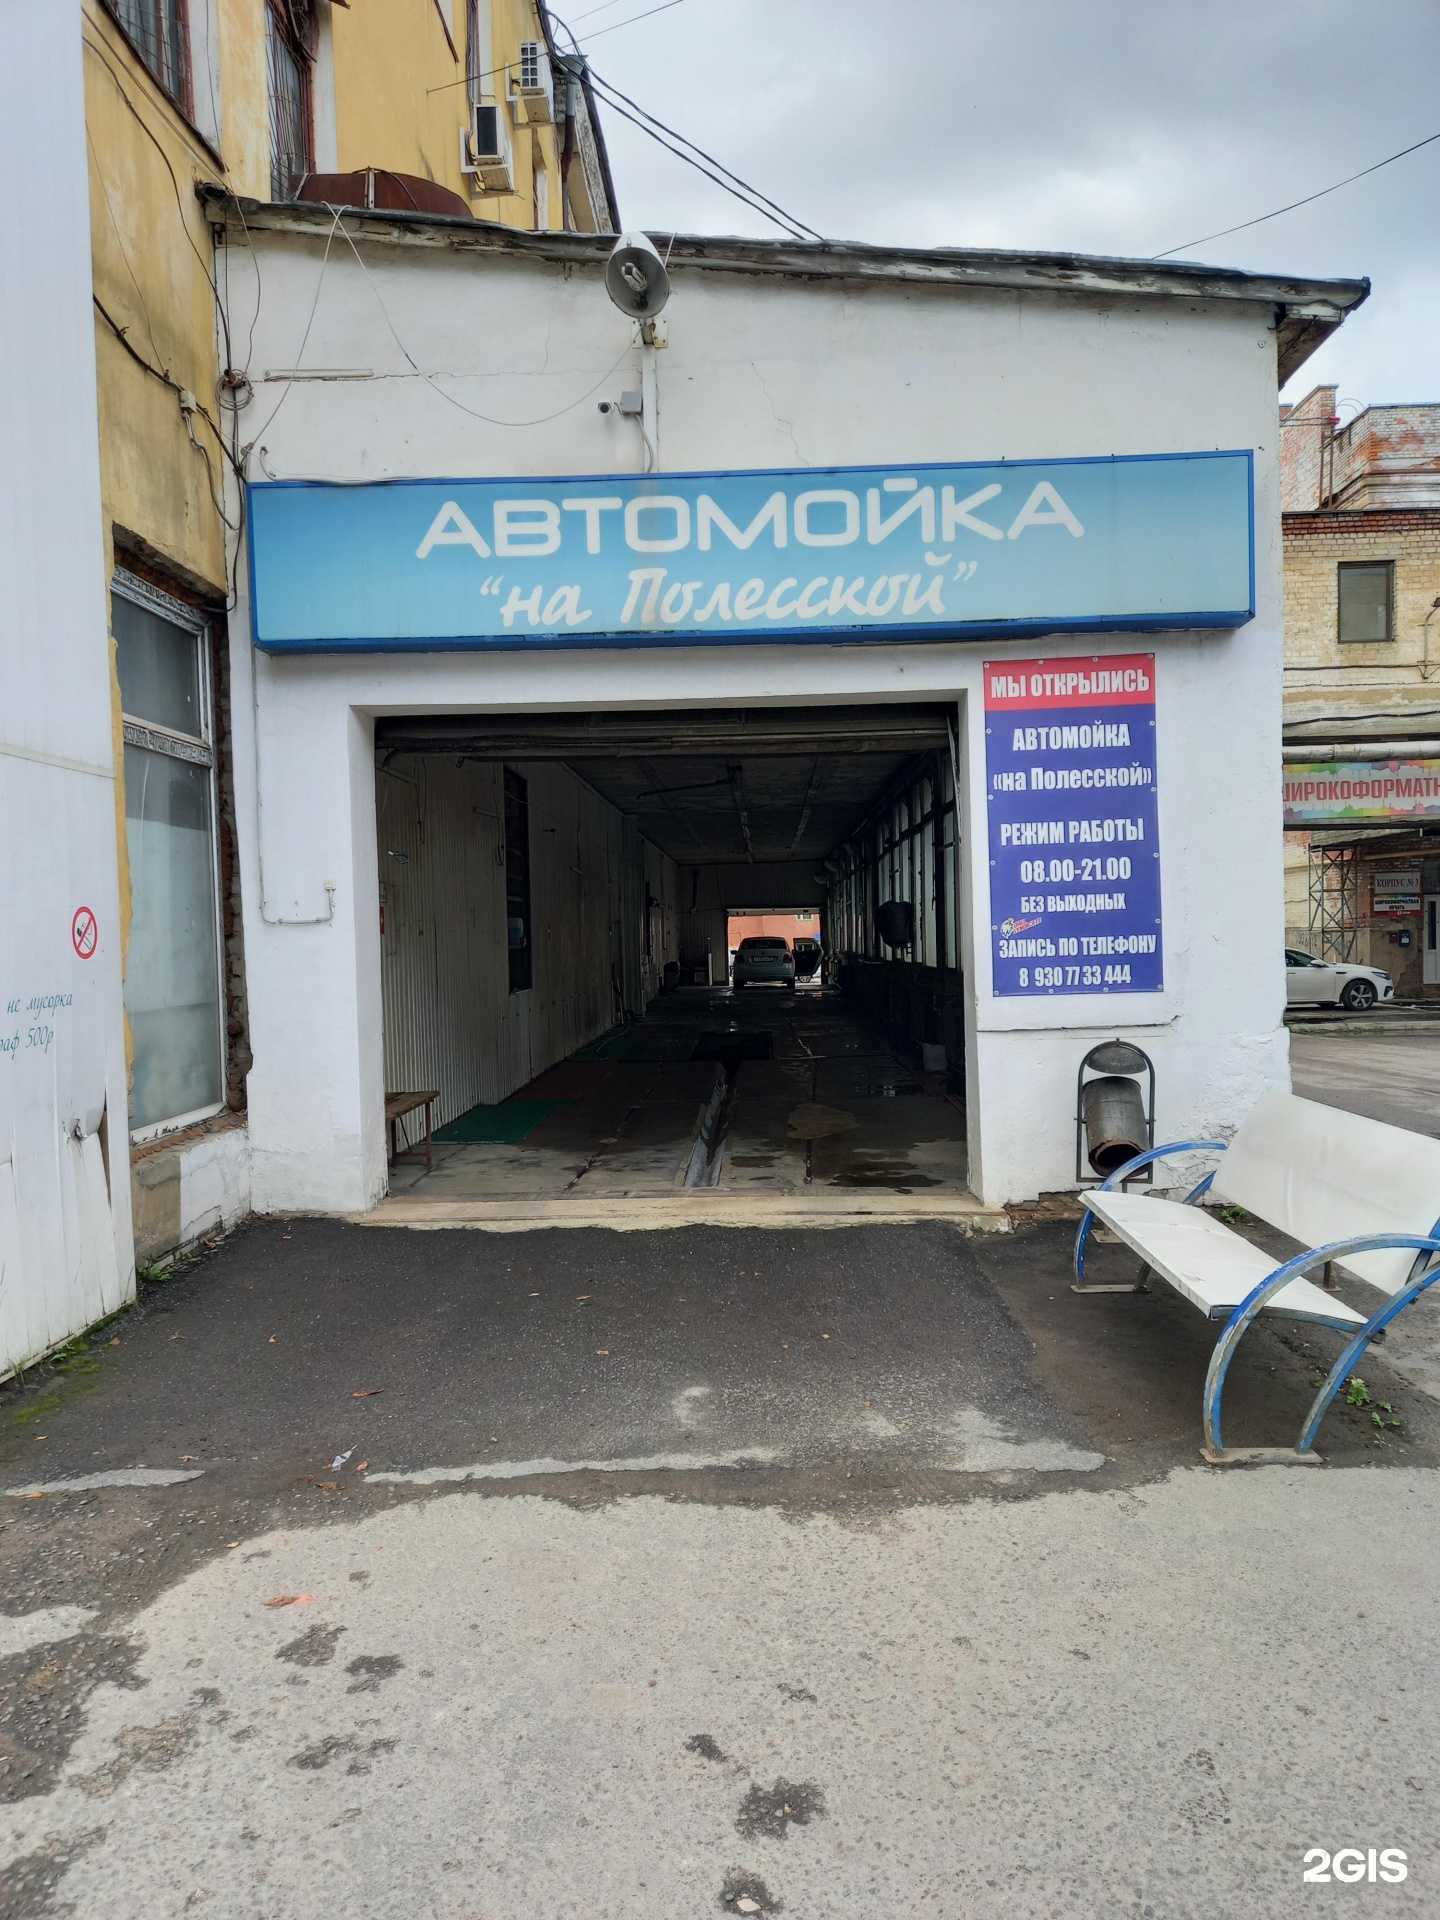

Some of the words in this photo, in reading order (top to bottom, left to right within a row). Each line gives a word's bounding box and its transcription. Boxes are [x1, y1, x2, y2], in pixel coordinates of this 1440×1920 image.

[416, 477, 1085, 559] АВТОМОЙКА
[991, 675, 1027, 699] МЫ
[1030, 669, 1150, 698] ОТКРЫЛИСЬ
[1012, 720, 1131, 751] АВТОМОЙКА
[1001, 821, 1065, 846] РЕЖИМ
[1068, 818, 1145, 843] РАБОТЫ
[1020, 856, 1132, 884] 08.00-21.00
[1021, 895, 1045, 914] БЕЗ
[1047, 892, 1127, 914] ВЫХОДНЫХ
[999, 938, 1056, 959] ЗАПИСЬ
[1059, 937, 1079, 956] ПО
[1080, 934, 1156, 956] ТЕЛЕФОНУ
[1019, 967, 1029, 988] 8
[1034, 967, 1063, 988] 930
[1083, 965, 1102, 986] 33
[1104, 964, 1131, 986] 444
